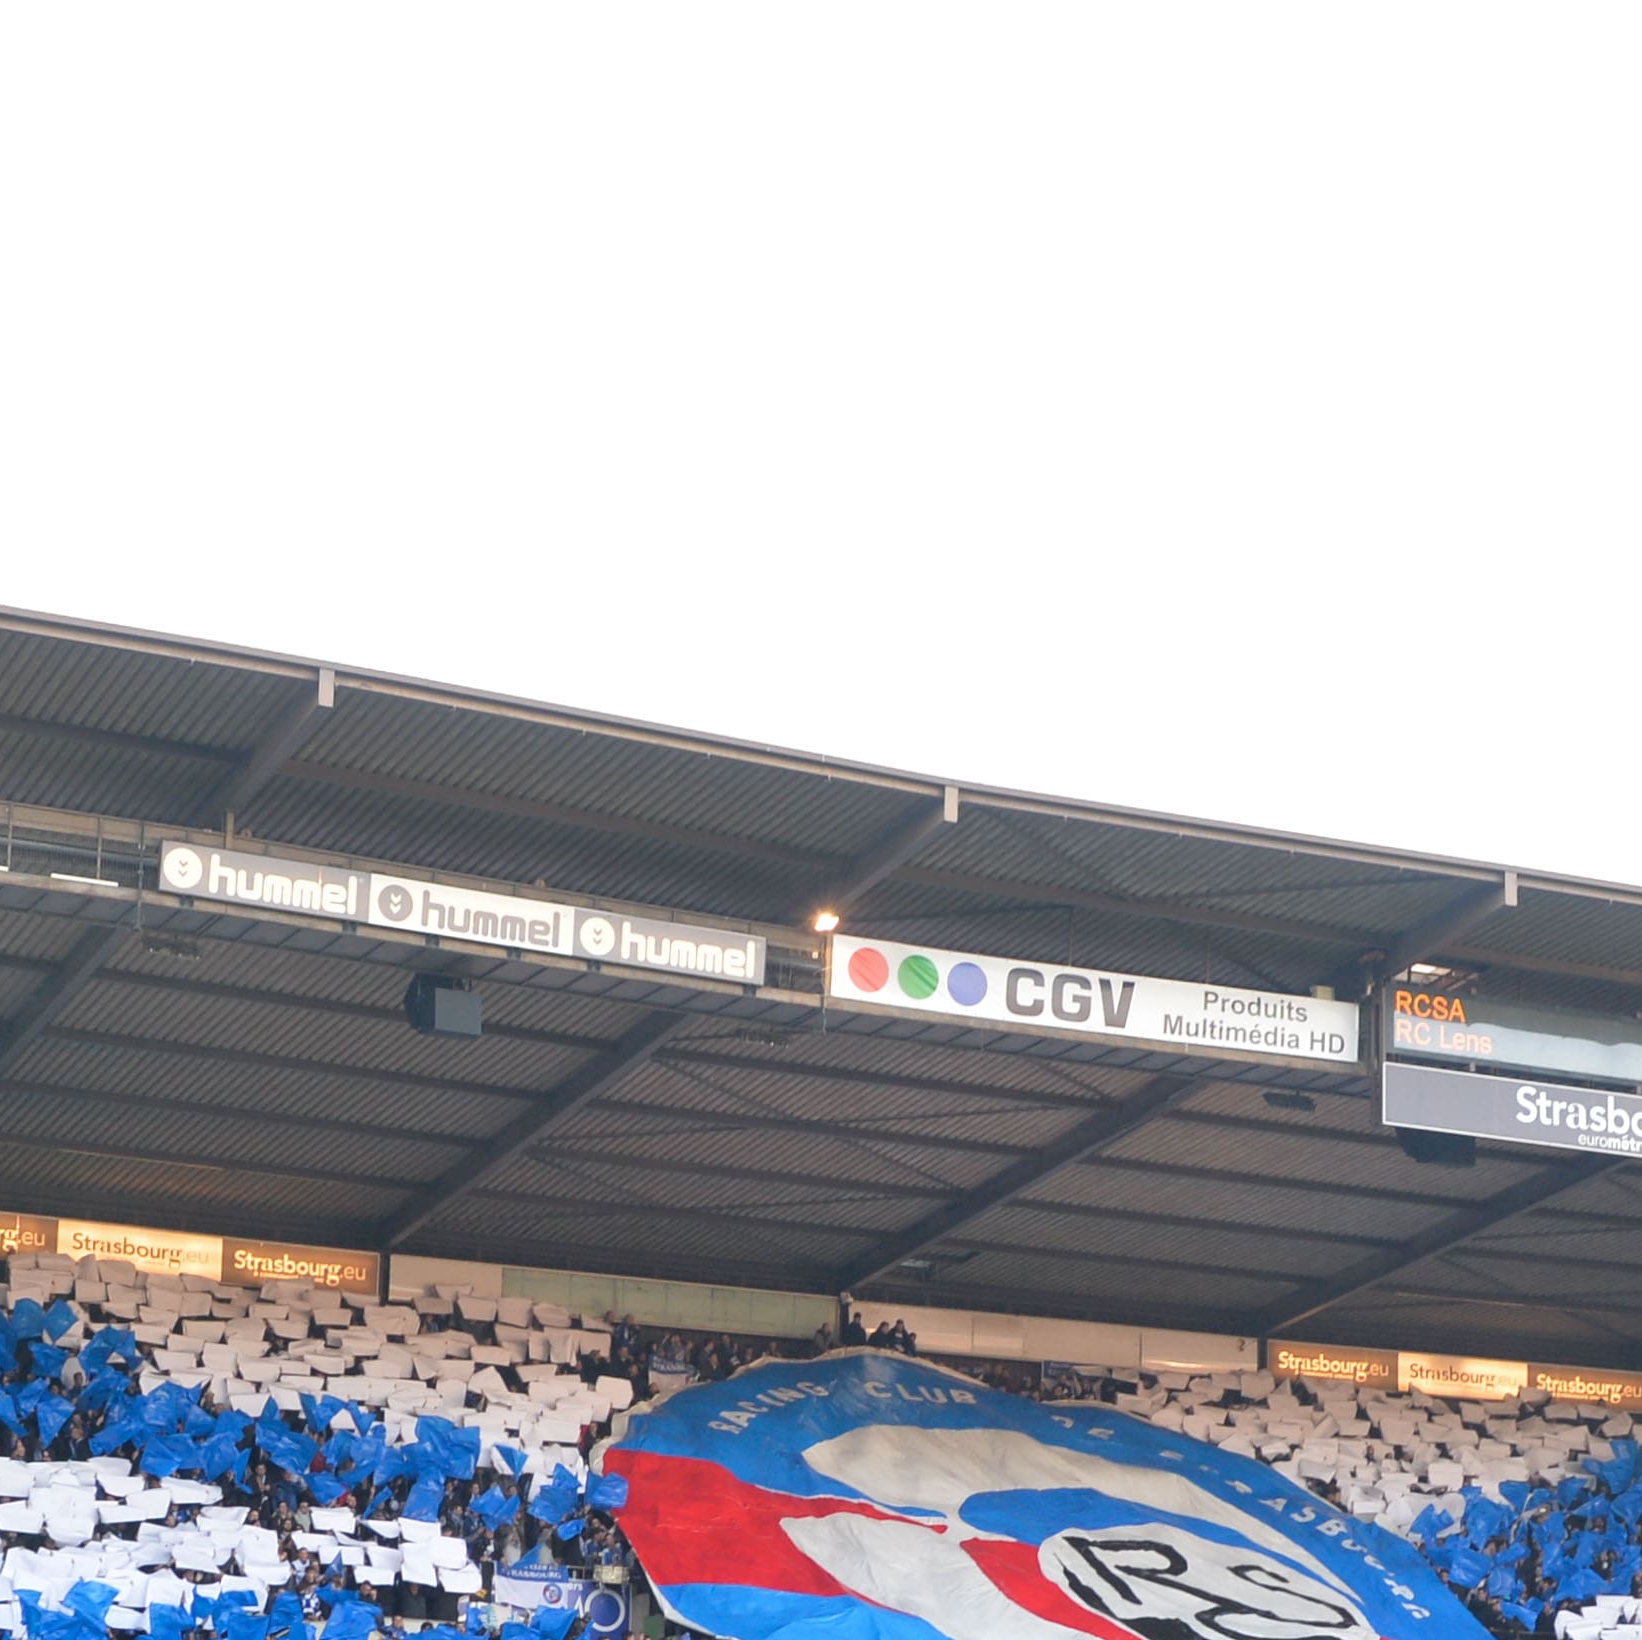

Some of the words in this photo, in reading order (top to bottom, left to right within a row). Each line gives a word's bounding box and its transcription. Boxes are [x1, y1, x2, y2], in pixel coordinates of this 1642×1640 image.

[209, 854, 356, 916] hummel
[422, 891, 561, 947] hummel
[622, 921, 755, 979] hummel
[1006, 968, 1135, 1028] CGV
[1203, 991, 1308, 1024] Produits
[1395, 990, 1466, 1024] RCSA
[1163, 1015, 1300, 1049] Multimédia
[1309, 1031, 1346, 1055] HD
[1395, 1019, 1432, 1047] RC
[1439, 1027, 1493, 1054] Lens
[708, 1381, 829, 1435] RACING
[864, 1380, 977, 1405] CLUB
